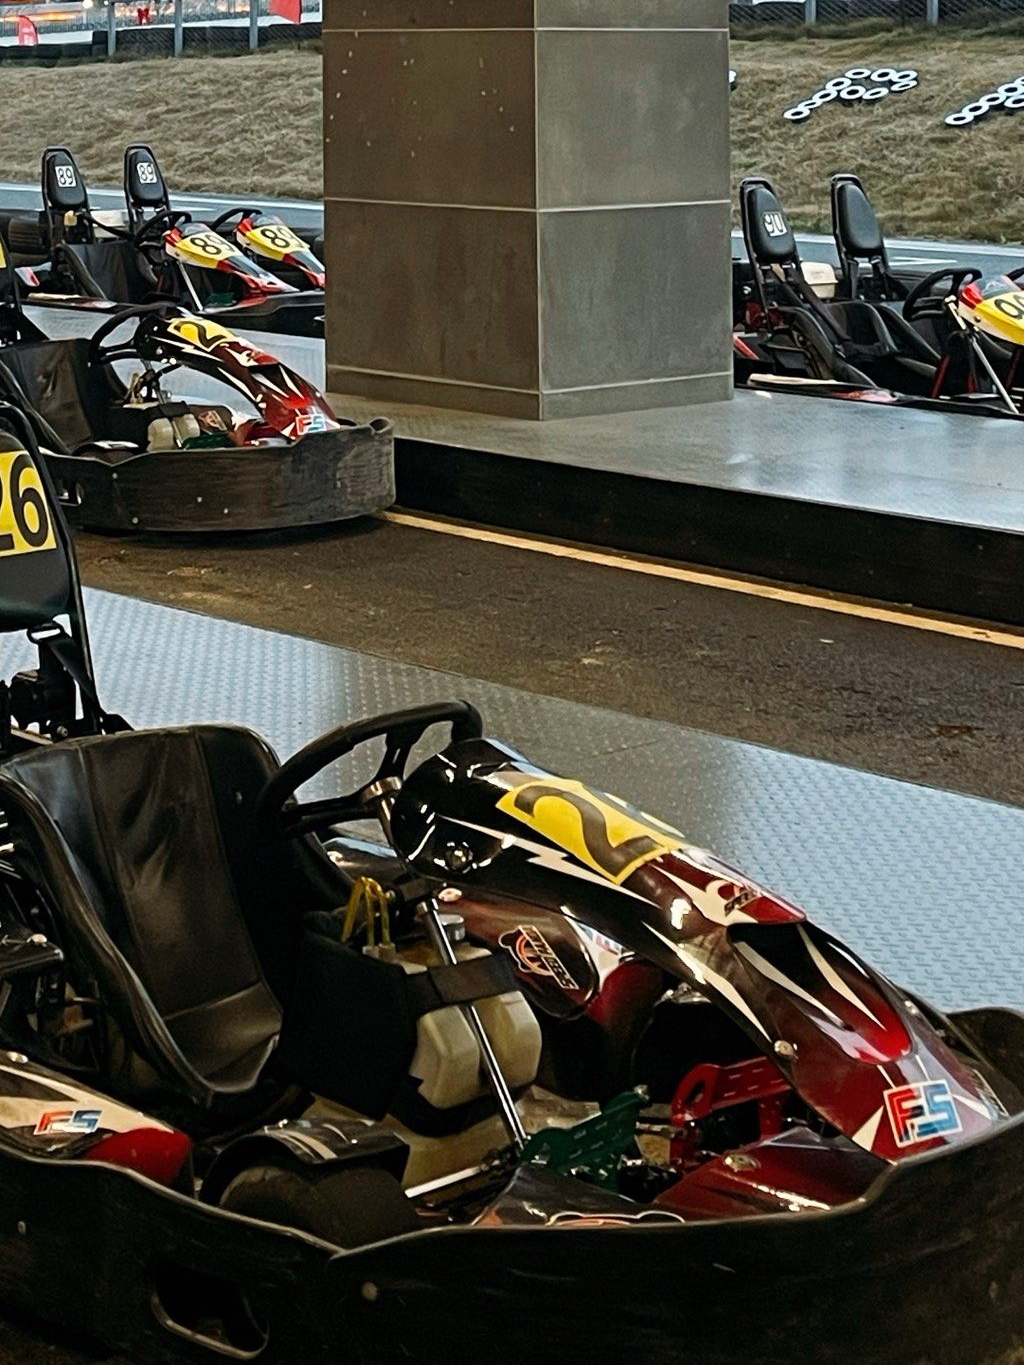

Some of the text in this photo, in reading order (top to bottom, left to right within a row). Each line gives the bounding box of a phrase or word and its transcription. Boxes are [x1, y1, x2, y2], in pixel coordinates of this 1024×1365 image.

[58, 167, 74, 185] 89
[139, 163, 155, 181] 89
[32, 1108, 103, 1135] FS
[884, 1079, 963, 1147] FS
